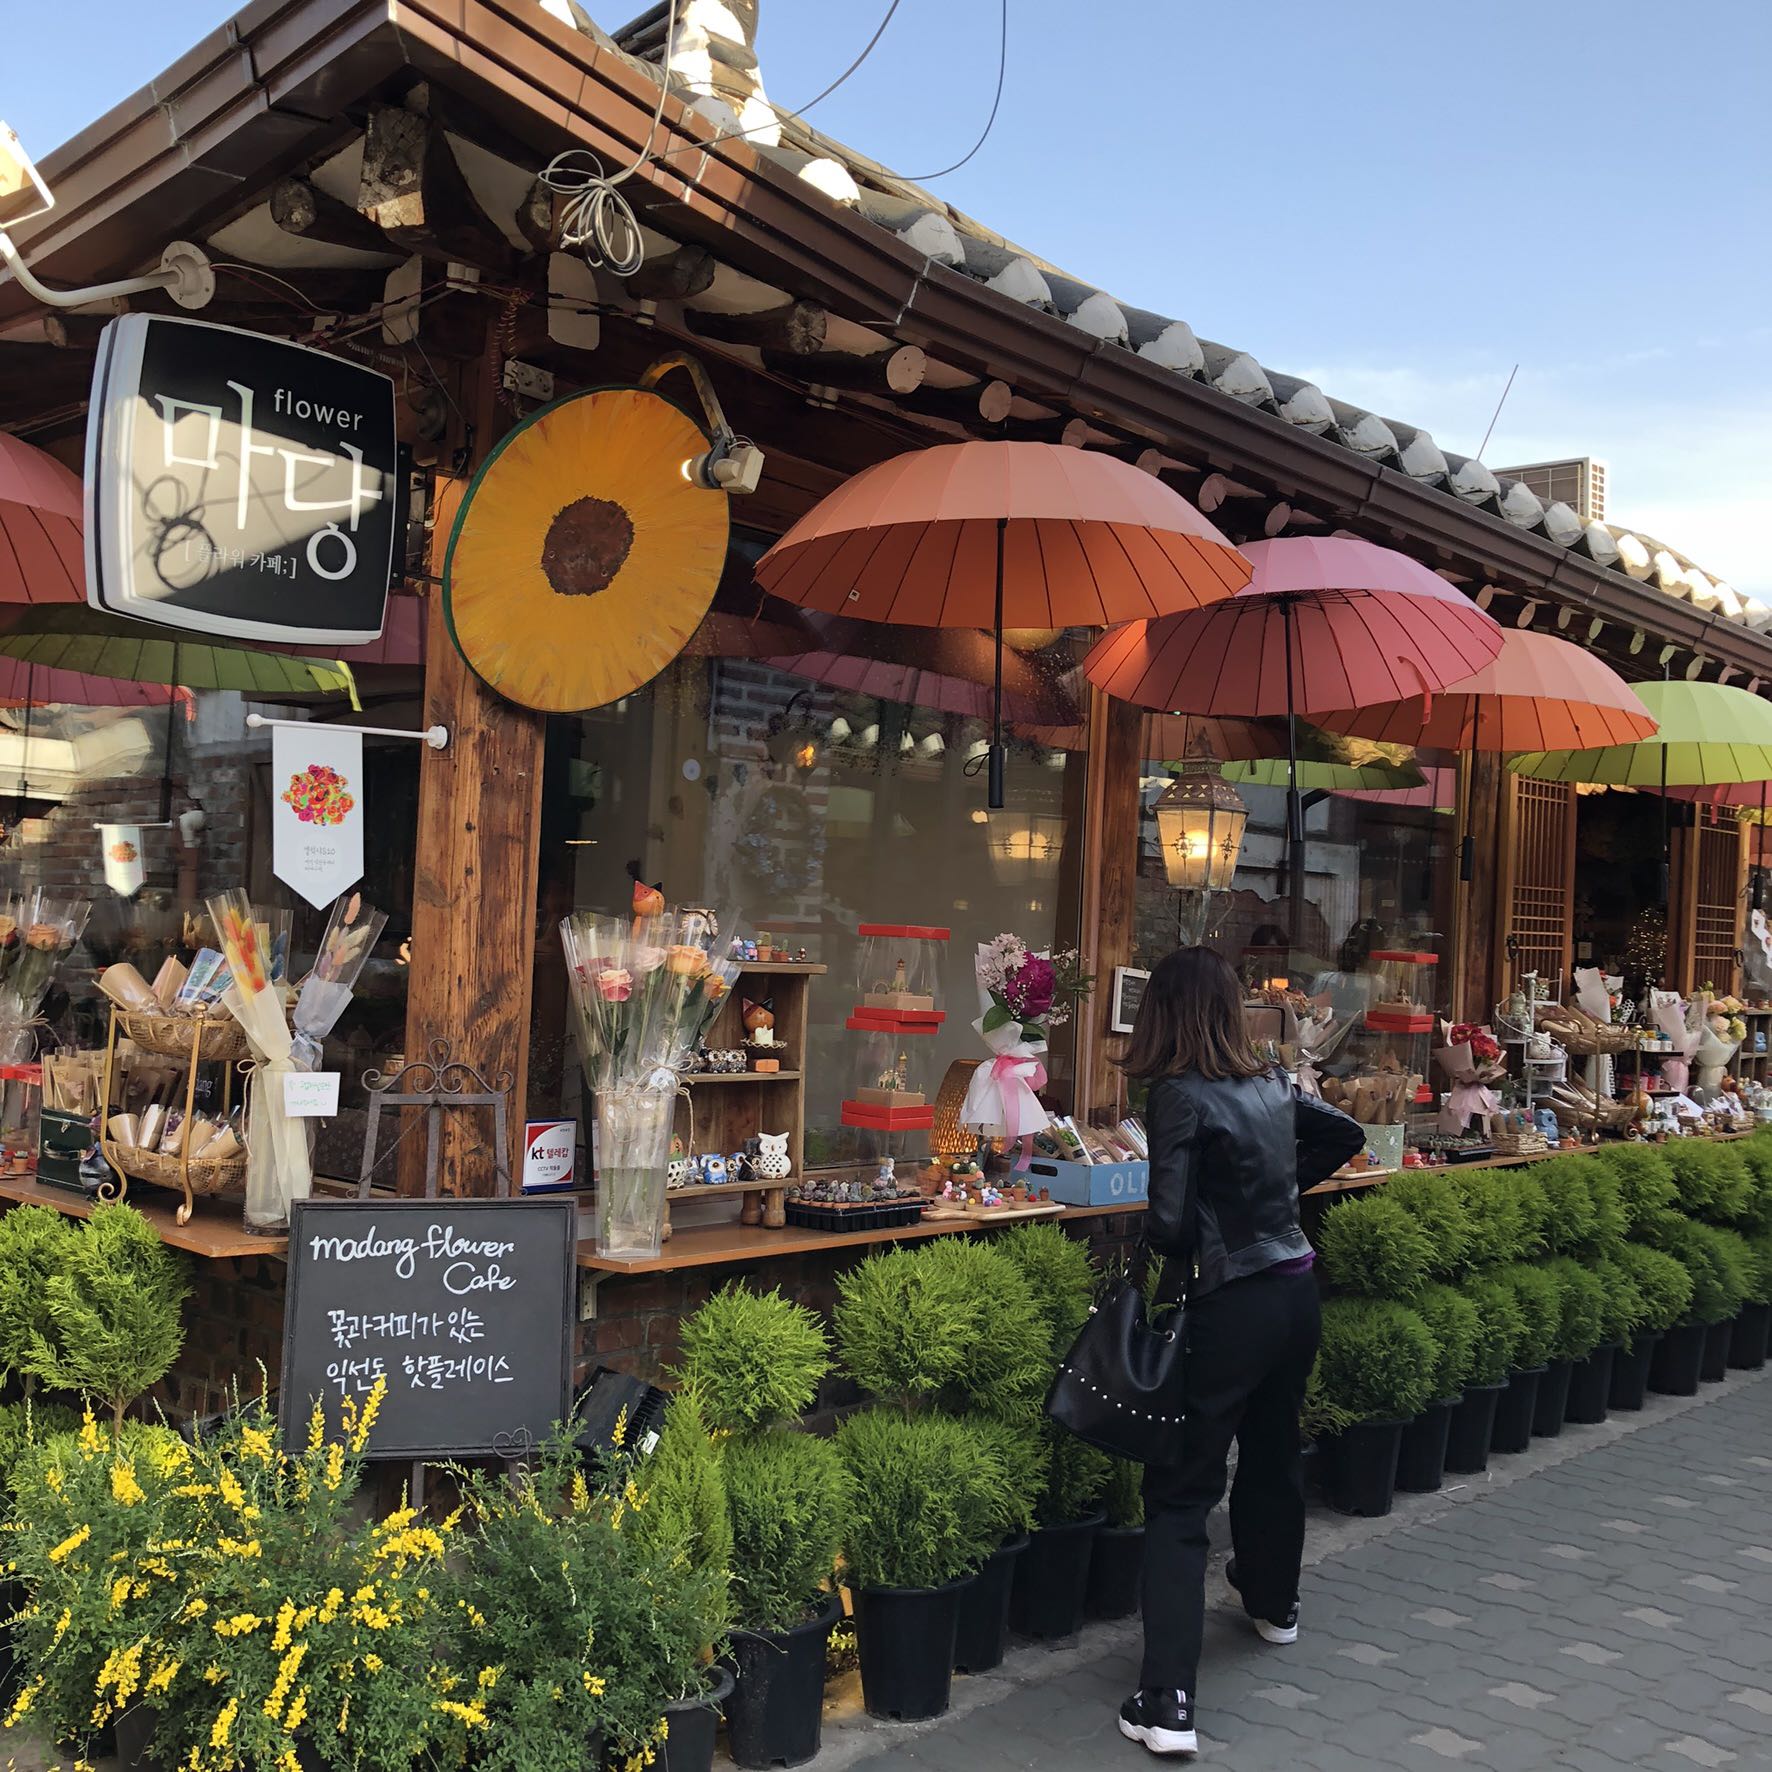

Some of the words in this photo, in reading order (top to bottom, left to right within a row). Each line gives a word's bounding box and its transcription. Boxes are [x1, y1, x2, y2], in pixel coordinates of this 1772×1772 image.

[274, 389, 363, 431] flower
[154, 380, 383, 581] 마당
[531, 1147, 545, 1160] kt
[421, 1224, 515, 1259] flower
[443, 1261, 517, 1295] Cafe
[447, 1306, 485, 1344] 있는
[401, 1354, 515, 1390] 핫플레이스
